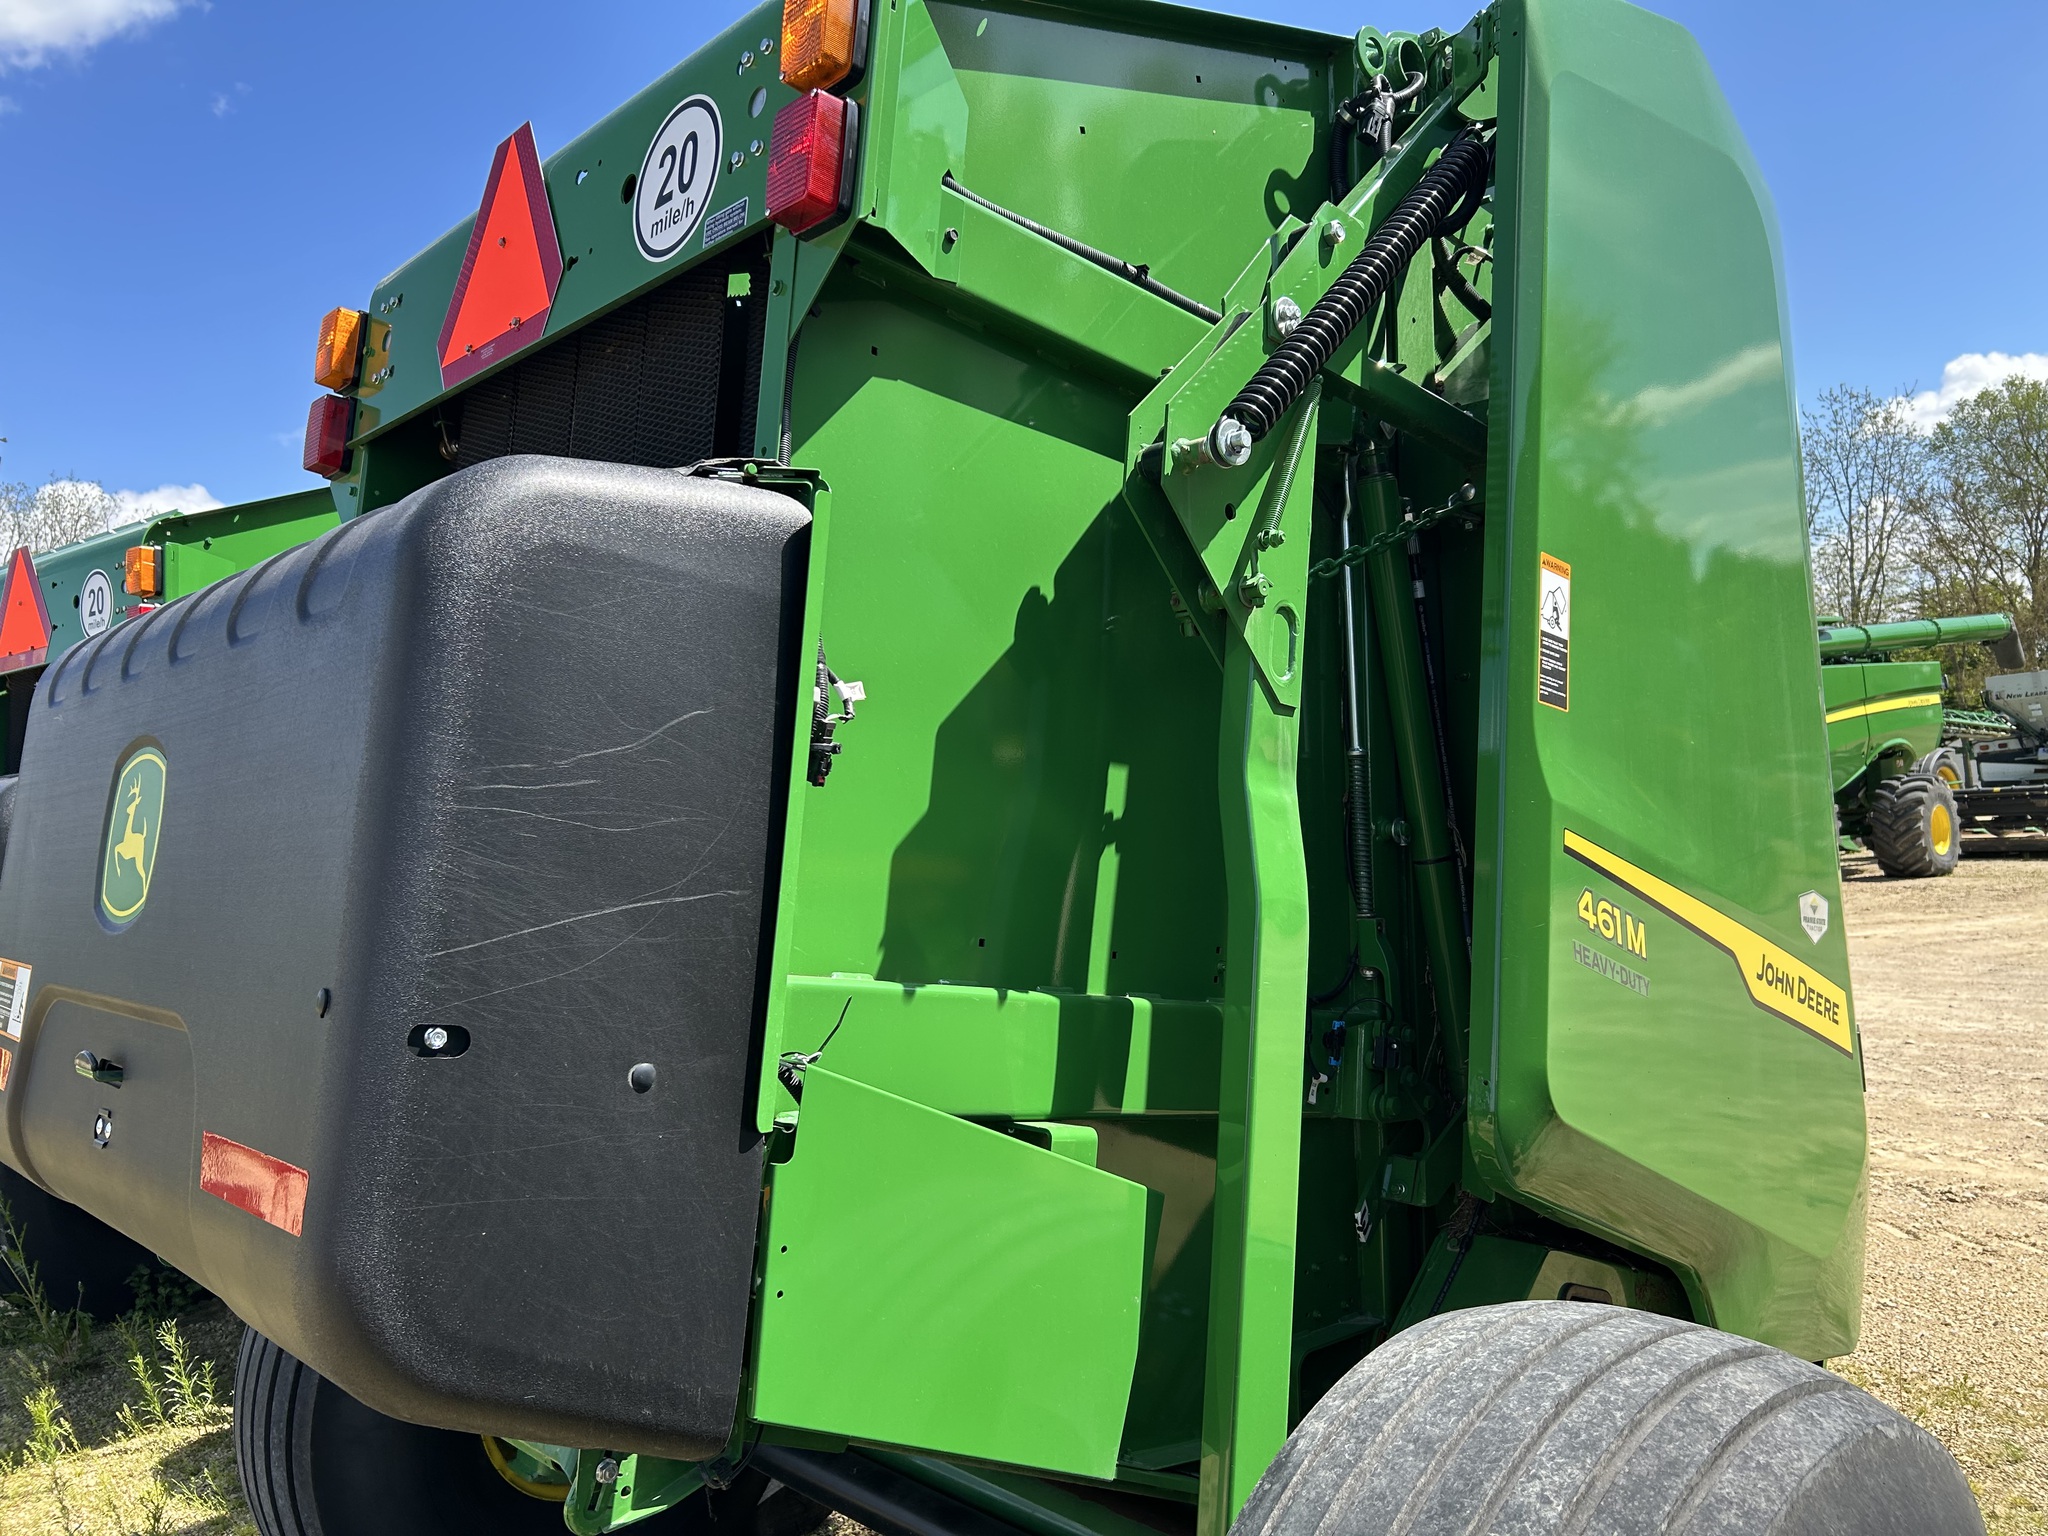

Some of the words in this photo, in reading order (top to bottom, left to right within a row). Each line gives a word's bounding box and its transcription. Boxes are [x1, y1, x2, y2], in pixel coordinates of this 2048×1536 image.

[654, 130, 698, 211] 20
[650, 197, 695, 239] mile/h
[1545, 558, 1570, 577] WARNING
[88, 585, 104, 617] 20
[1572, 940, 1650, 997] HEAVY-DUTY
